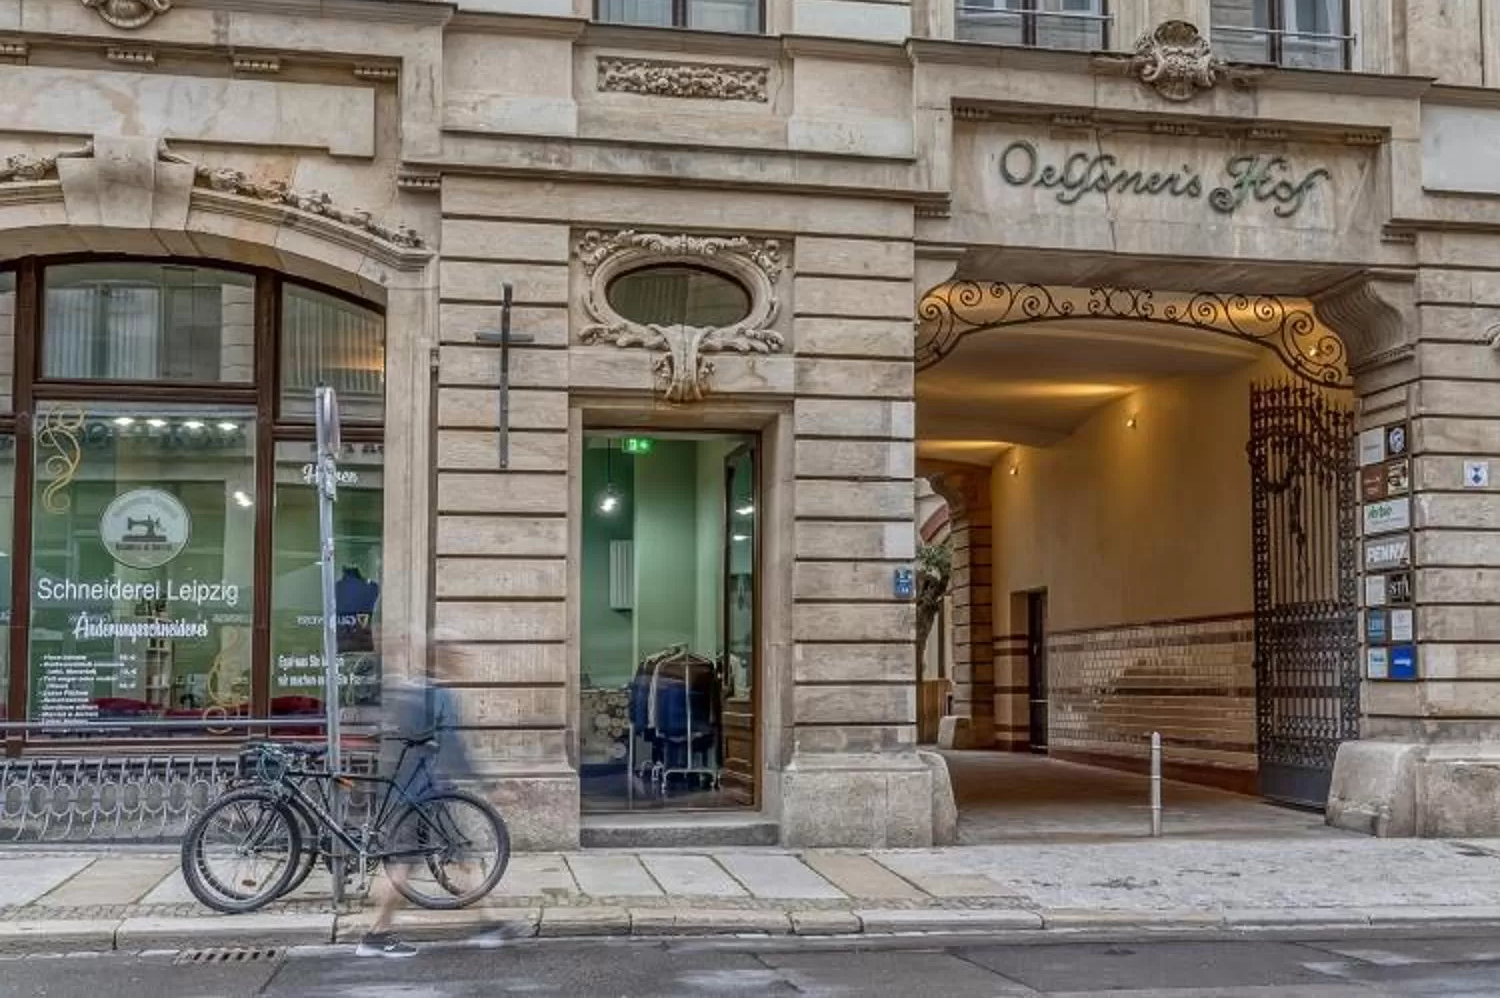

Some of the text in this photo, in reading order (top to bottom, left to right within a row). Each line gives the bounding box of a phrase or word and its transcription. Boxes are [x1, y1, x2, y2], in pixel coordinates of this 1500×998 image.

[1208, 155, 1332, 219] Hof
[37, 577, 239, 607] Schneiderei Leipzig
